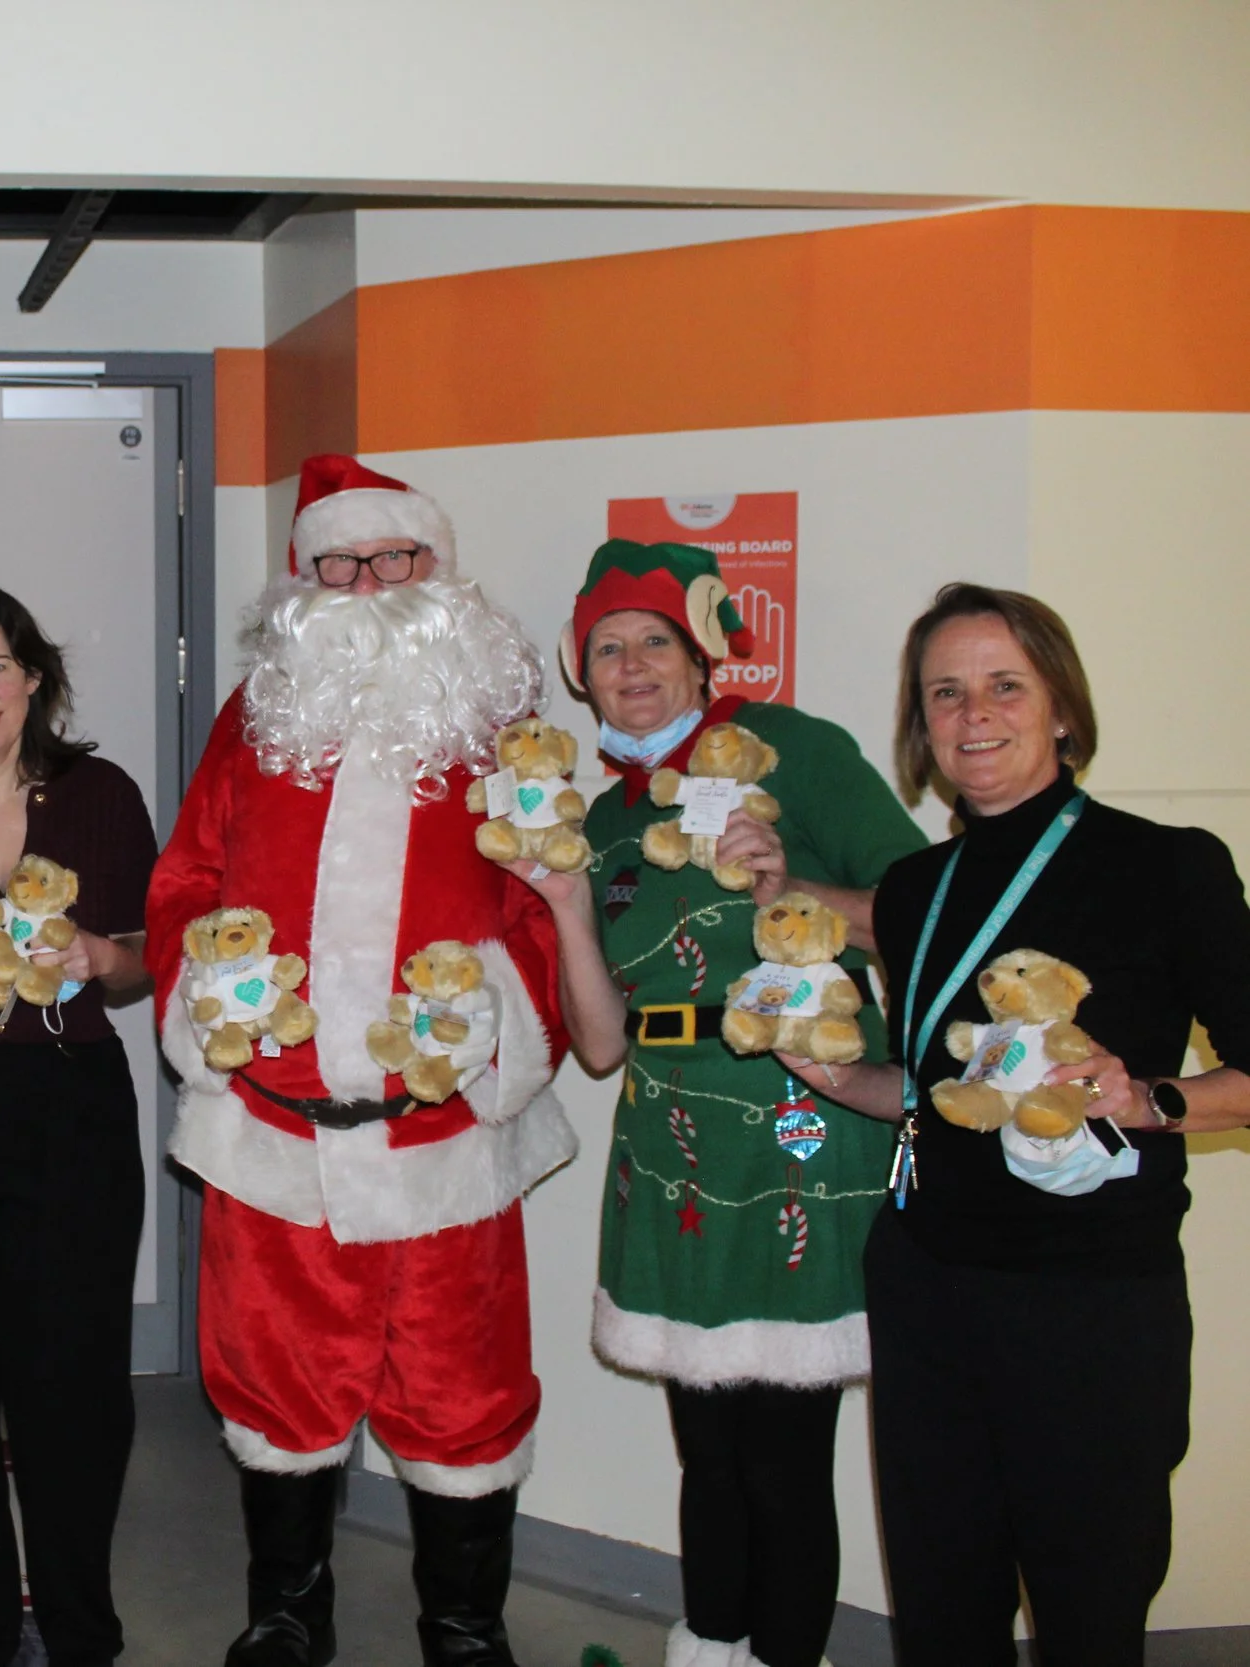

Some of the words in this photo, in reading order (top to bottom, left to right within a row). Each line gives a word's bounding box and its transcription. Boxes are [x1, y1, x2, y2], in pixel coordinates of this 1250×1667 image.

[739, 540, 792, 554] BOARD
[714, 663, 778, 684] STOP
[1030, 849, 1050, 869] The
[1000, 871, 1035, 913] Friends
[989, 913, 1006, 930] of
[954, 927, 997, 978] Conquest
